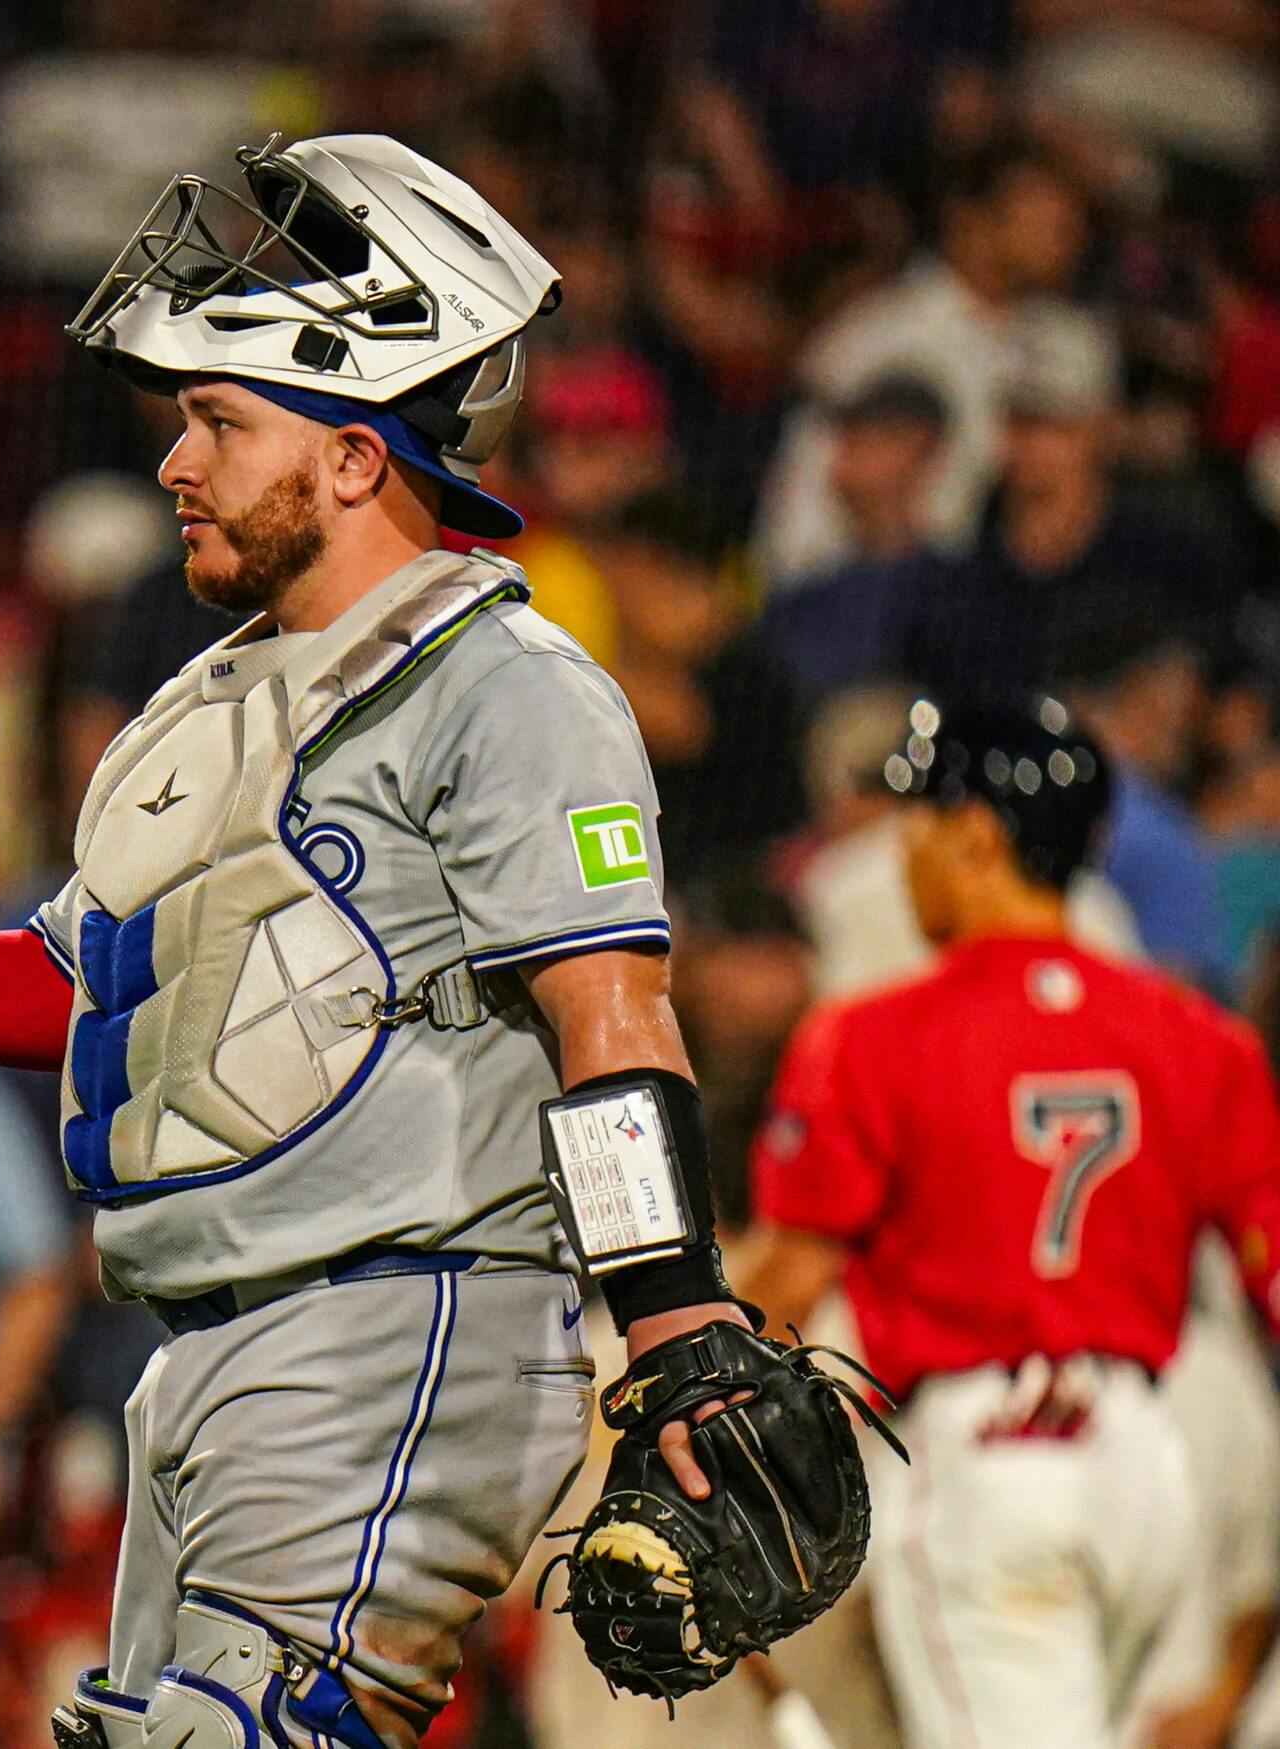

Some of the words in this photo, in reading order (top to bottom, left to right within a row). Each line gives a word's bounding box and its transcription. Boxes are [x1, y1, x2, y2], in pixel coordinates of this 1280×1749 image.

[582, 819, 648, 869] TD
[1009, 1068, 1143, 1281] 7
[640, 1178, 660, 1224] LITTLE
